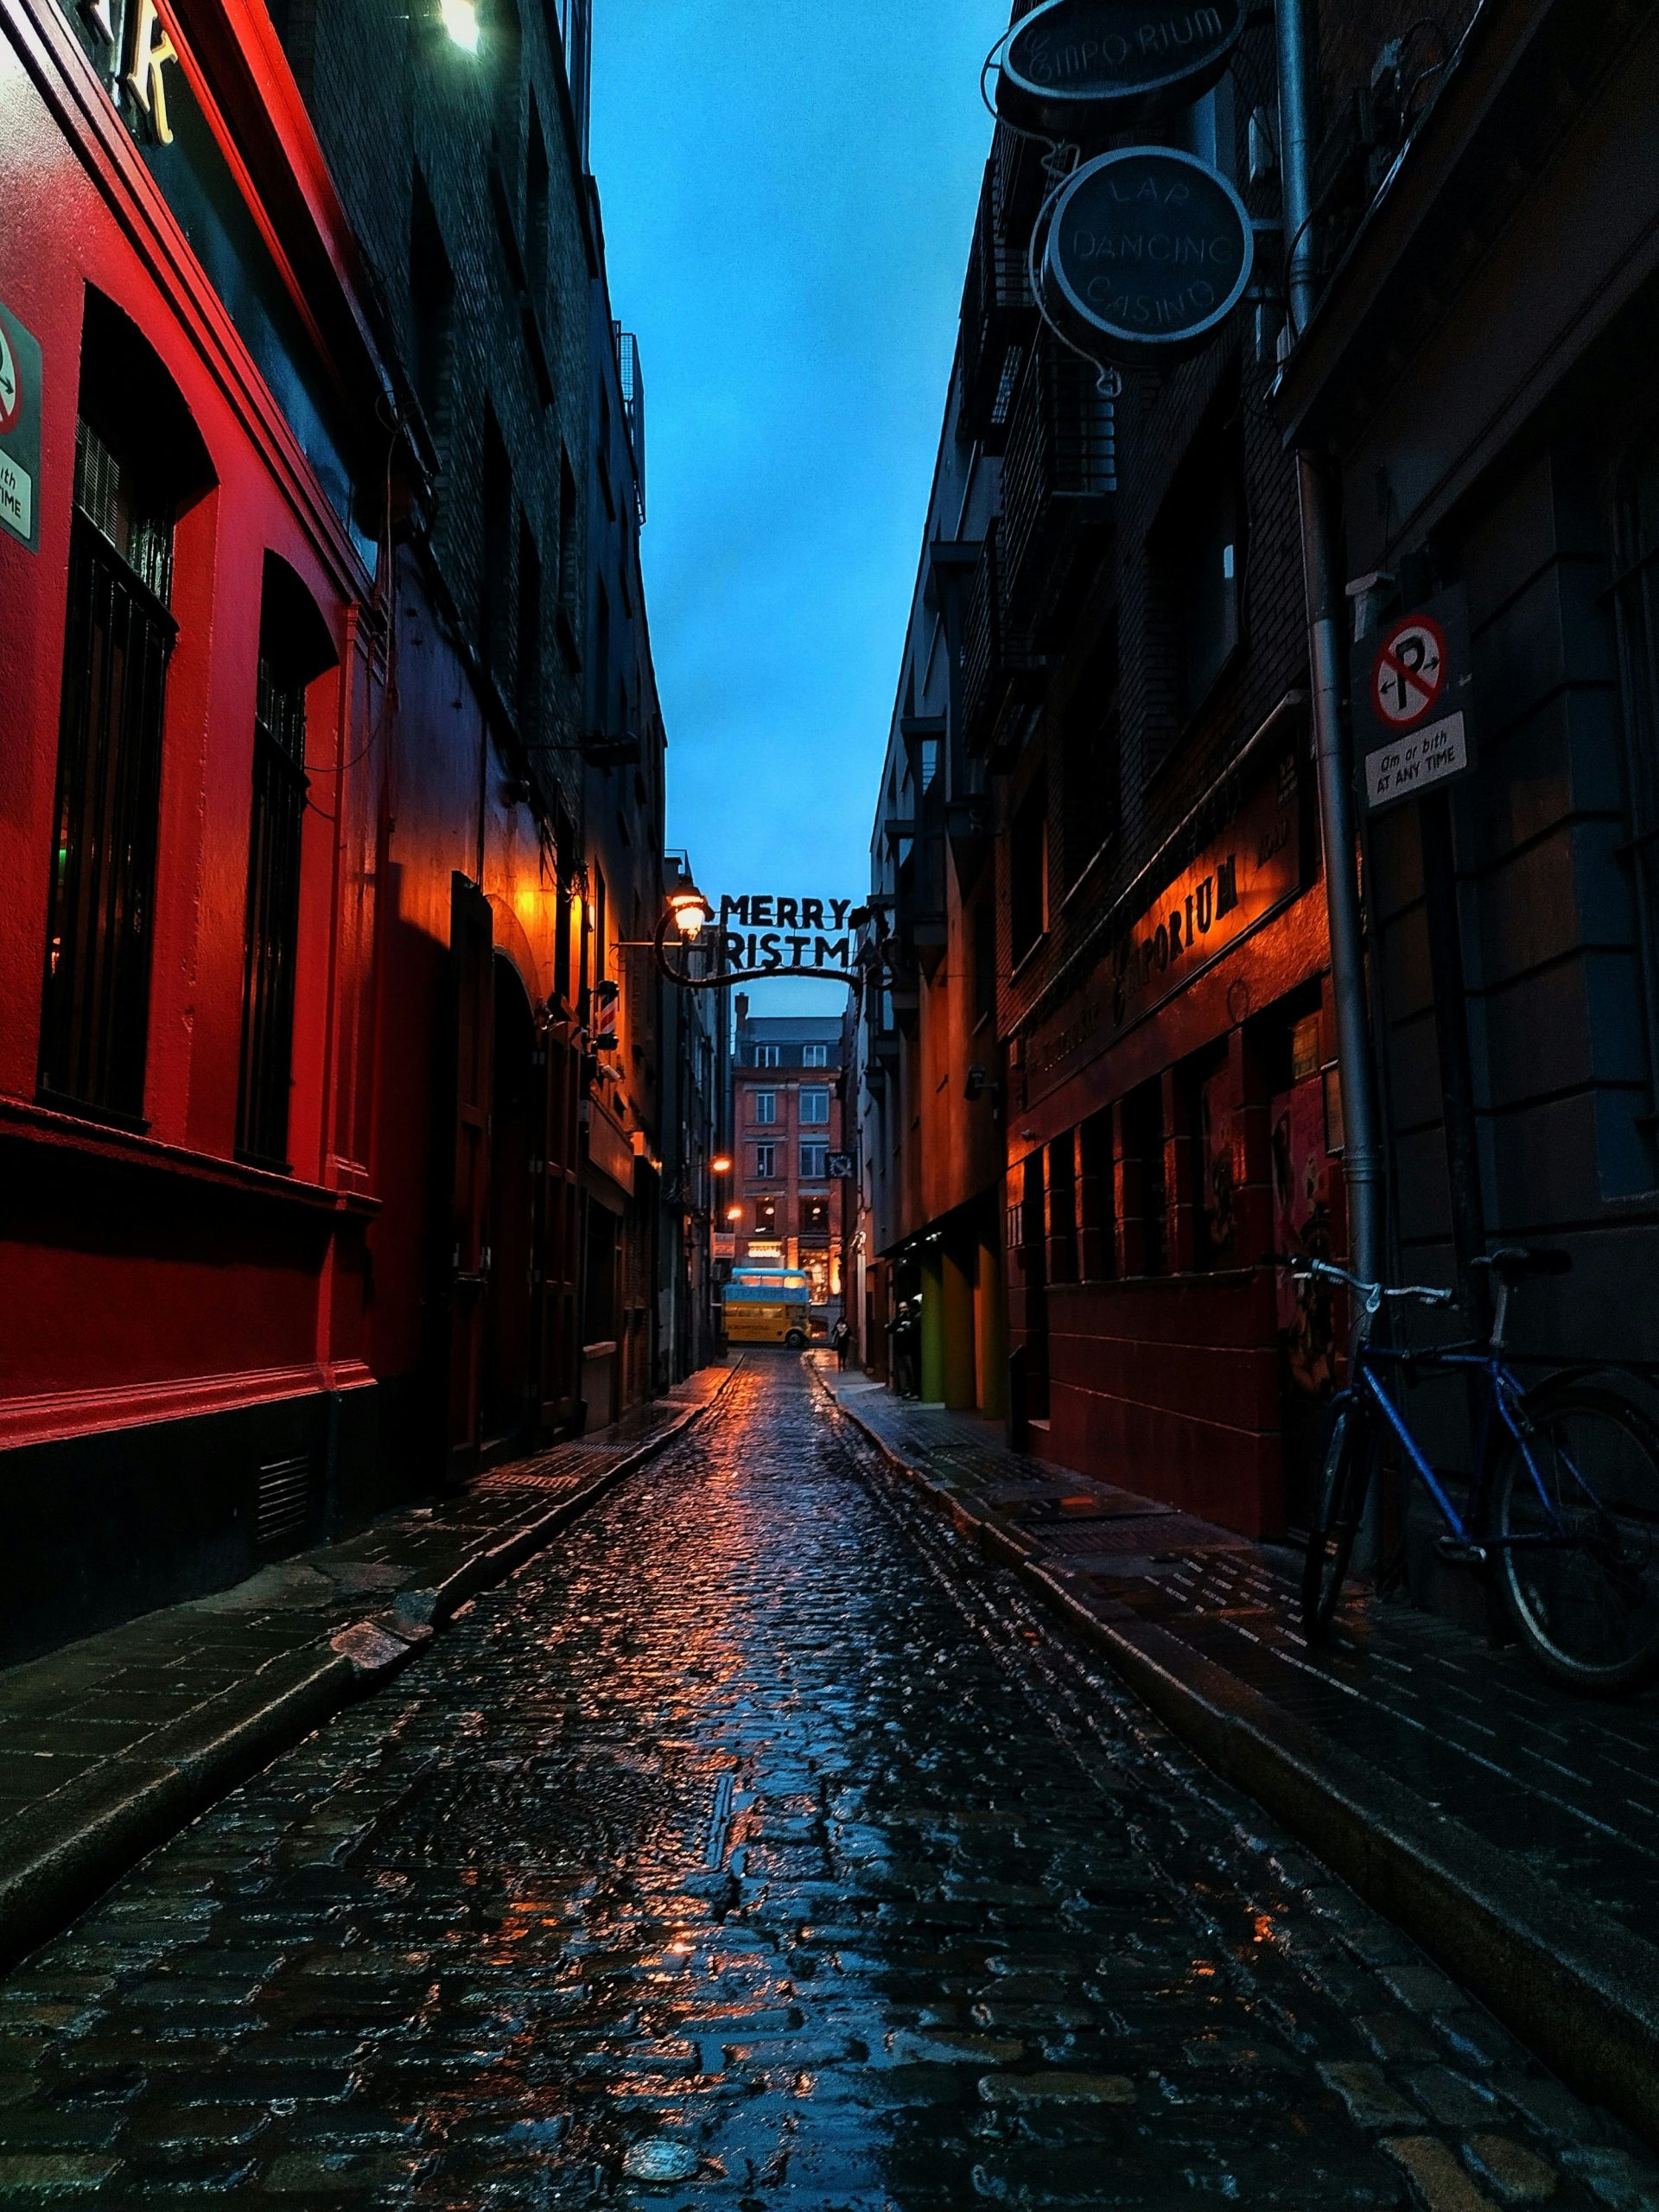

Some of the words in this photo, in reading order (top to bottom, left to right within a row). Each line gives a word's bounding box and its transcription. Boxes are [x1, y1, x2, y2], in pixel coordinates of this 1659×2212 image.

[1109, 177, 1190, 207] LAP
[1073, 230, 1234, 264] DANCING
[1087, 276, 1215, 323] CASINO
[0, 467, 16, 490] ith
[1376, 774, 1390, 794] AT
[1395, 760, 1421, 785] ANY
[1425, 746, 1455, 772] TIME
[721, 894, 851, 930] MERRY
